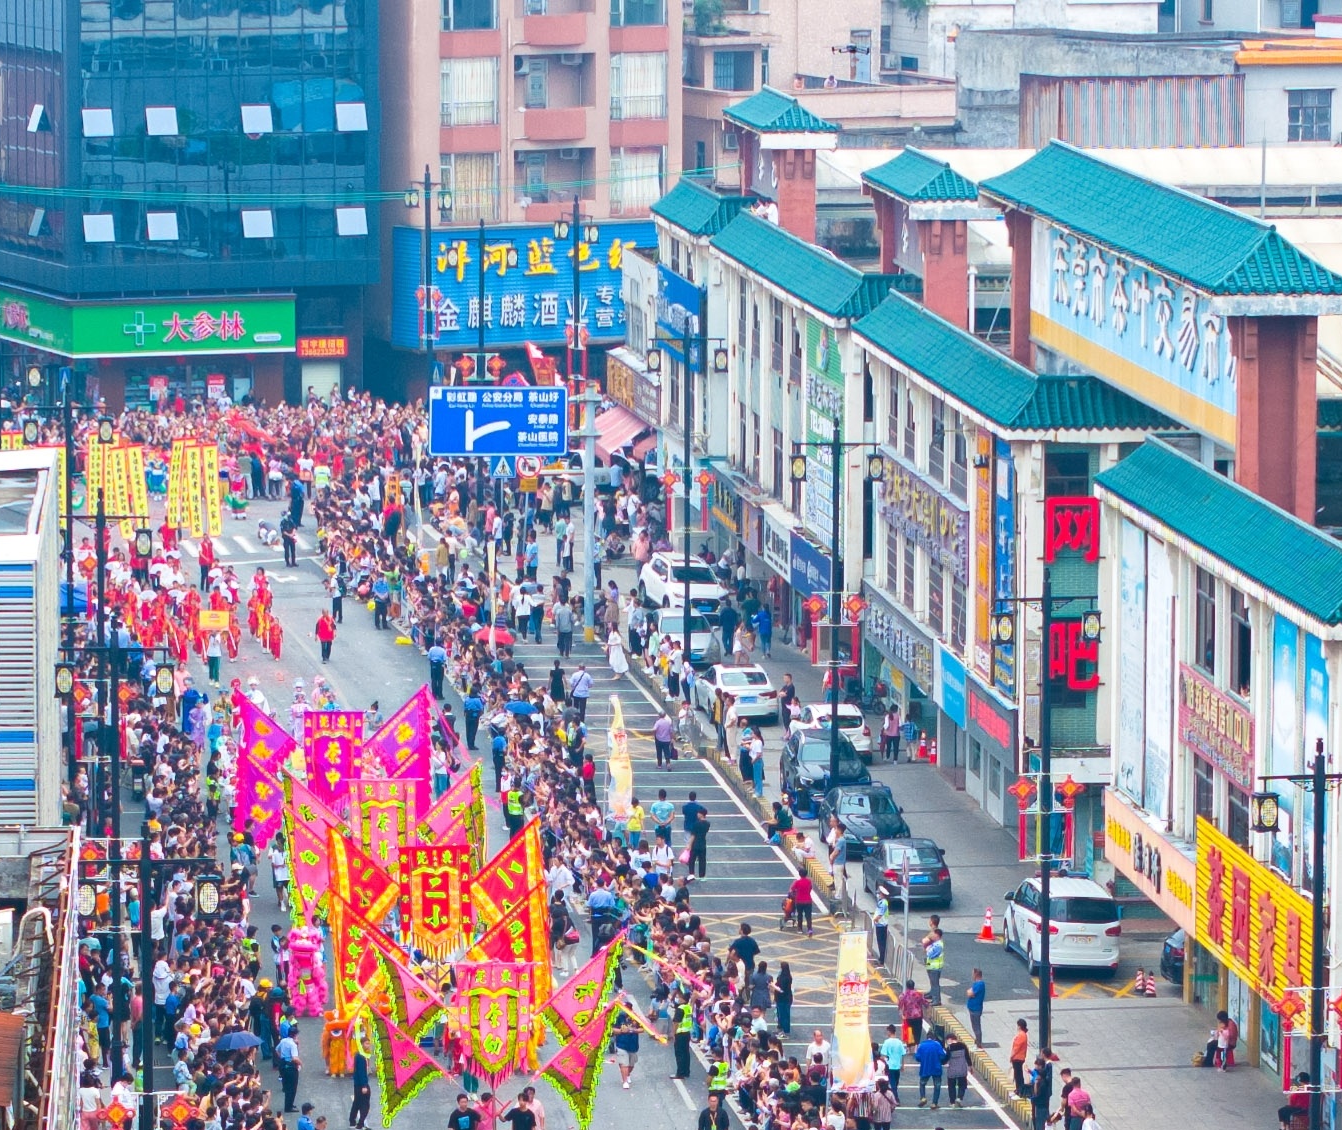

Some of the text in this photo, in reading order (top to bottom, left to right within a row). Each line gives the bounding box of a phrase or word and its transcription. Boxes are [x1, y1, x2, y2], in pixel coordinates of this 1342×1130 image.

[163, 310, 245, 343] 大参林
[1053, 232, 1237, 386] 东莞市茶叶交易市
